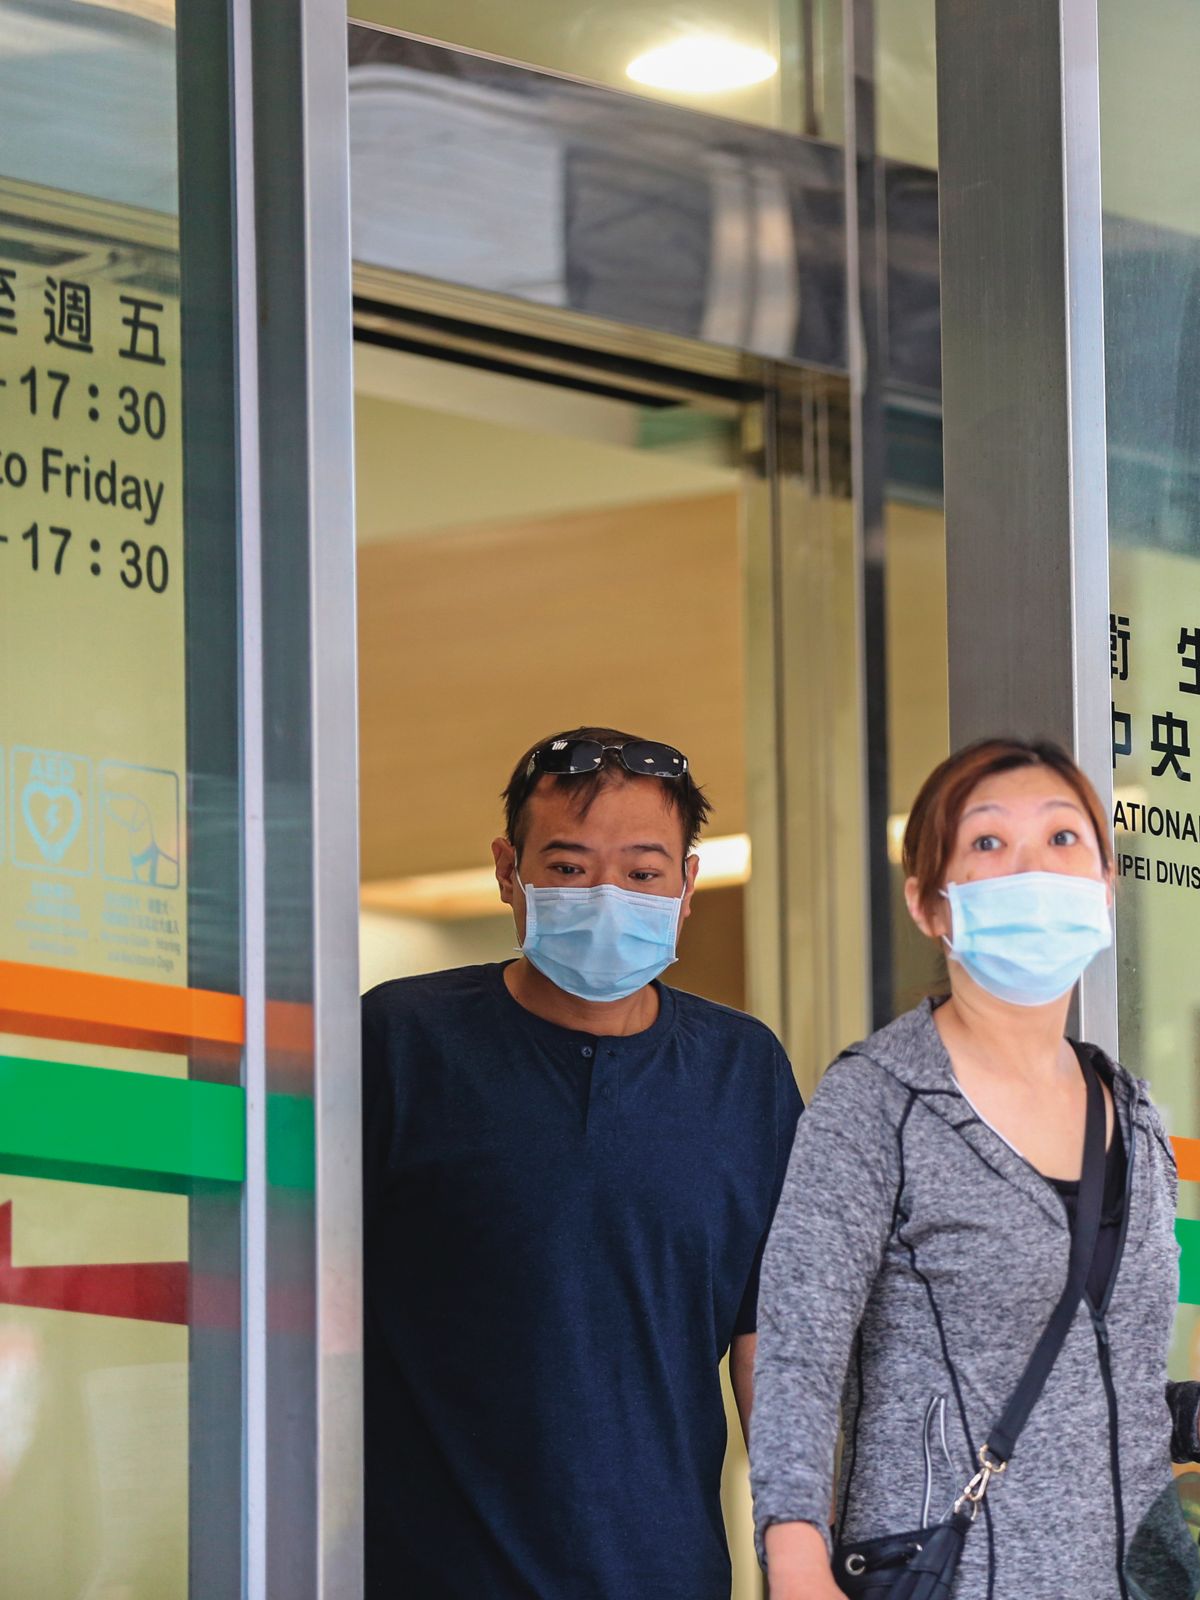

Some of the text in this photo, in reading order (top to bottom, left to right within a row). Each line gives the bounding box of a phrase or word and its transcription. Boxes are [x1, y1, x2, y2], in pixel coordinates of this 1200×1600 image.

[0, 446, 164, 526] o Friday
[1117, 853, 1151, 881] IPEI
